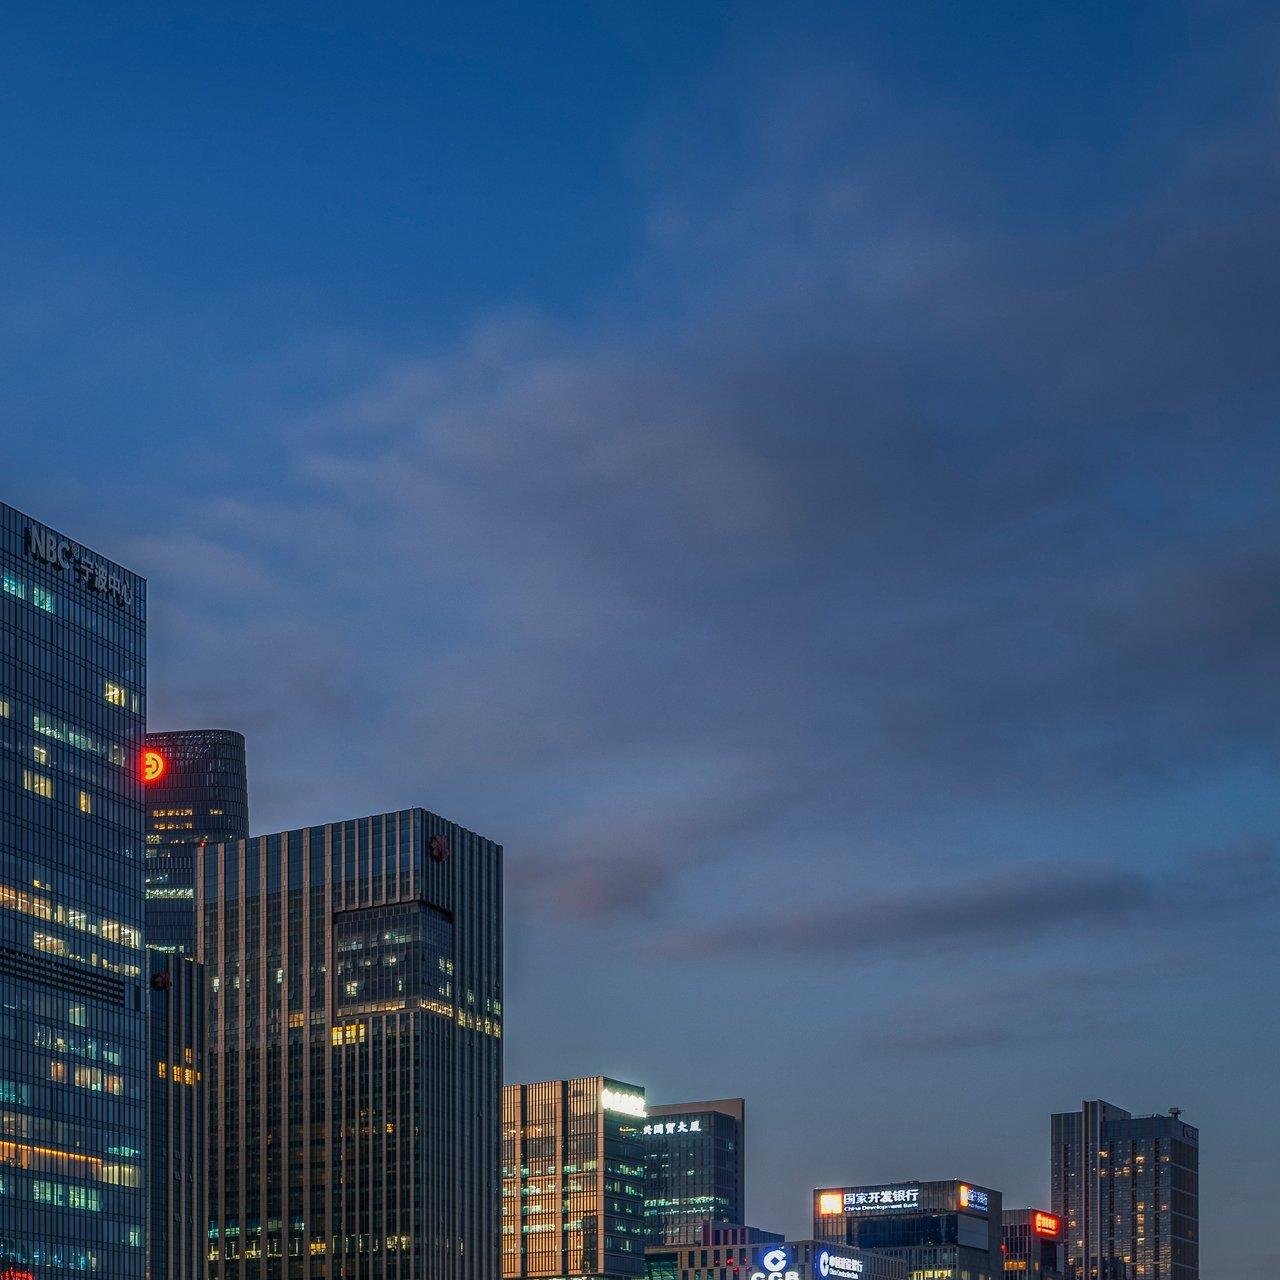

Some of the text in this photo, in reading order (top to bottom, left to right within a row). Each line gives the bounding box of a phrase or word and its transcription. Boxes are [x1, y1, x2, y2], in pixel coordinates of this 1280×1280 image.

[30, 525, 70, 570] NBC
[80, 557, 133, 605] 宁波中心
[843, 1188, 920, 1206] 国家开发银行
